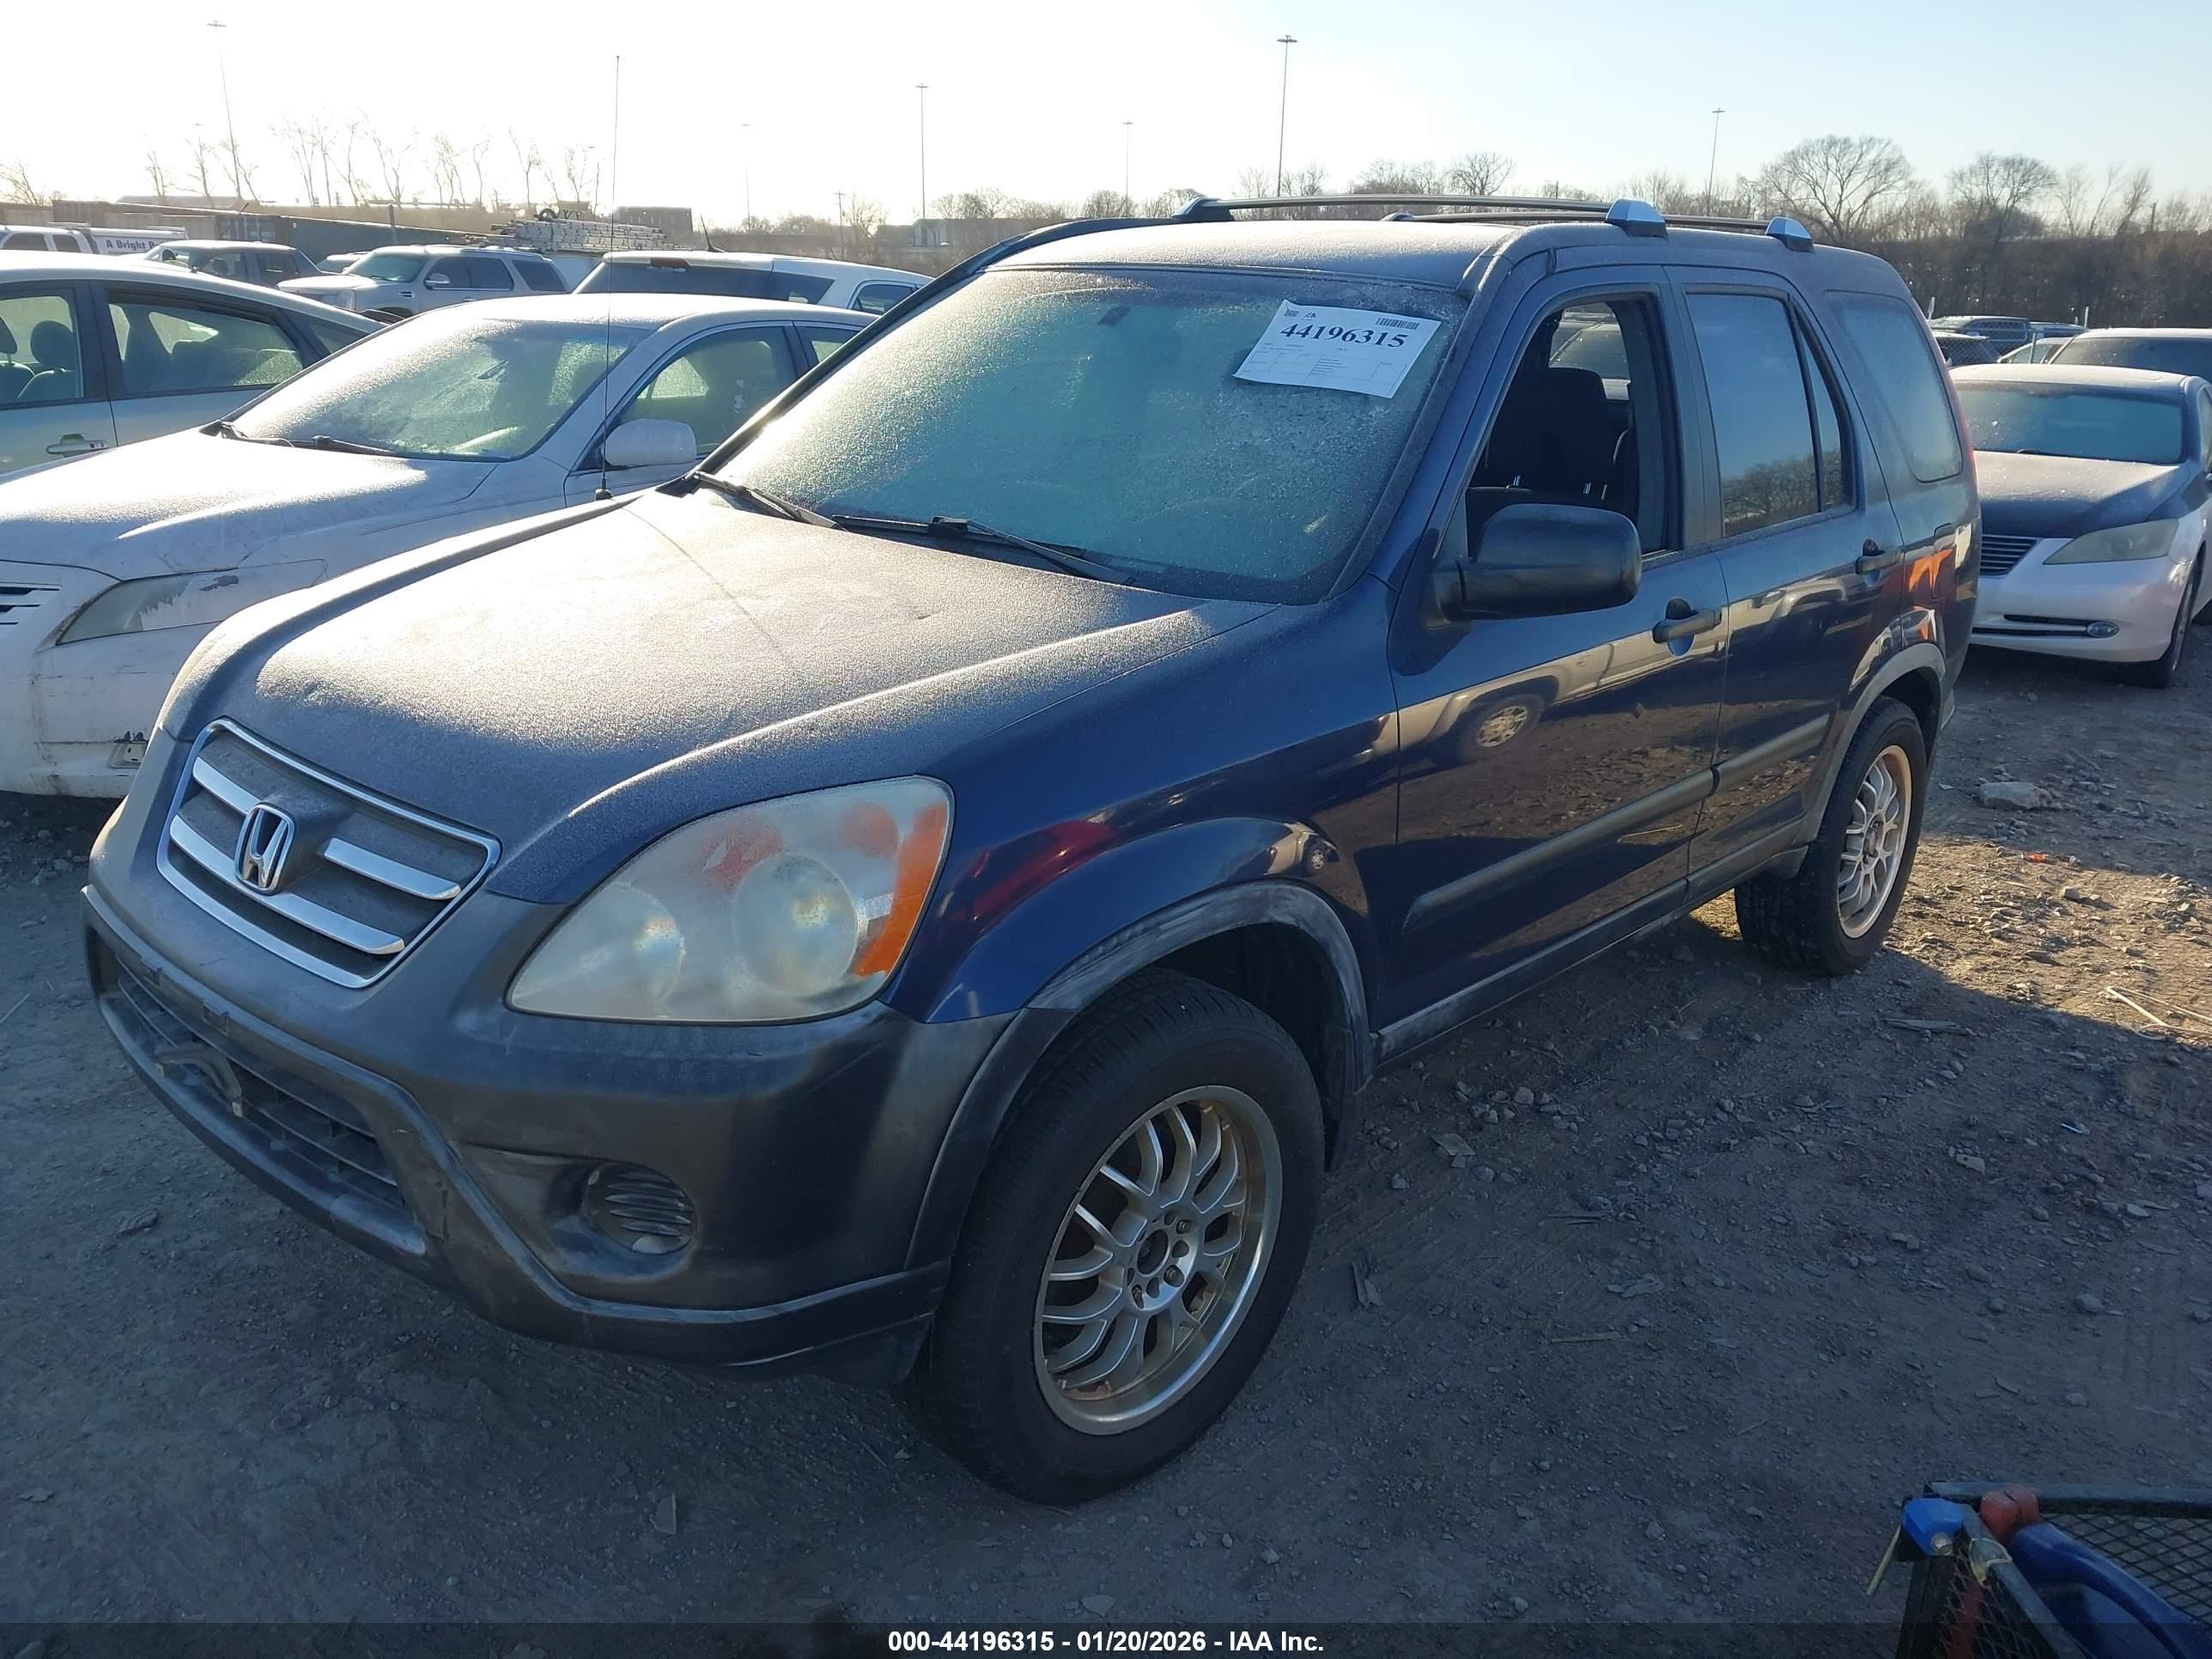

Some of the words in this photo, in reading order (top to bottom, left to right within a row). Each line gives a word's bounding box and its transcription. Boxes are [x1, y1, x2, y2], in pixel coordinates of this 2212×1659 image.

[106, 240, 113, 248] A
[116, 240, 146, 251] Bright
[1280, 323, 1409, 348] 44196315
